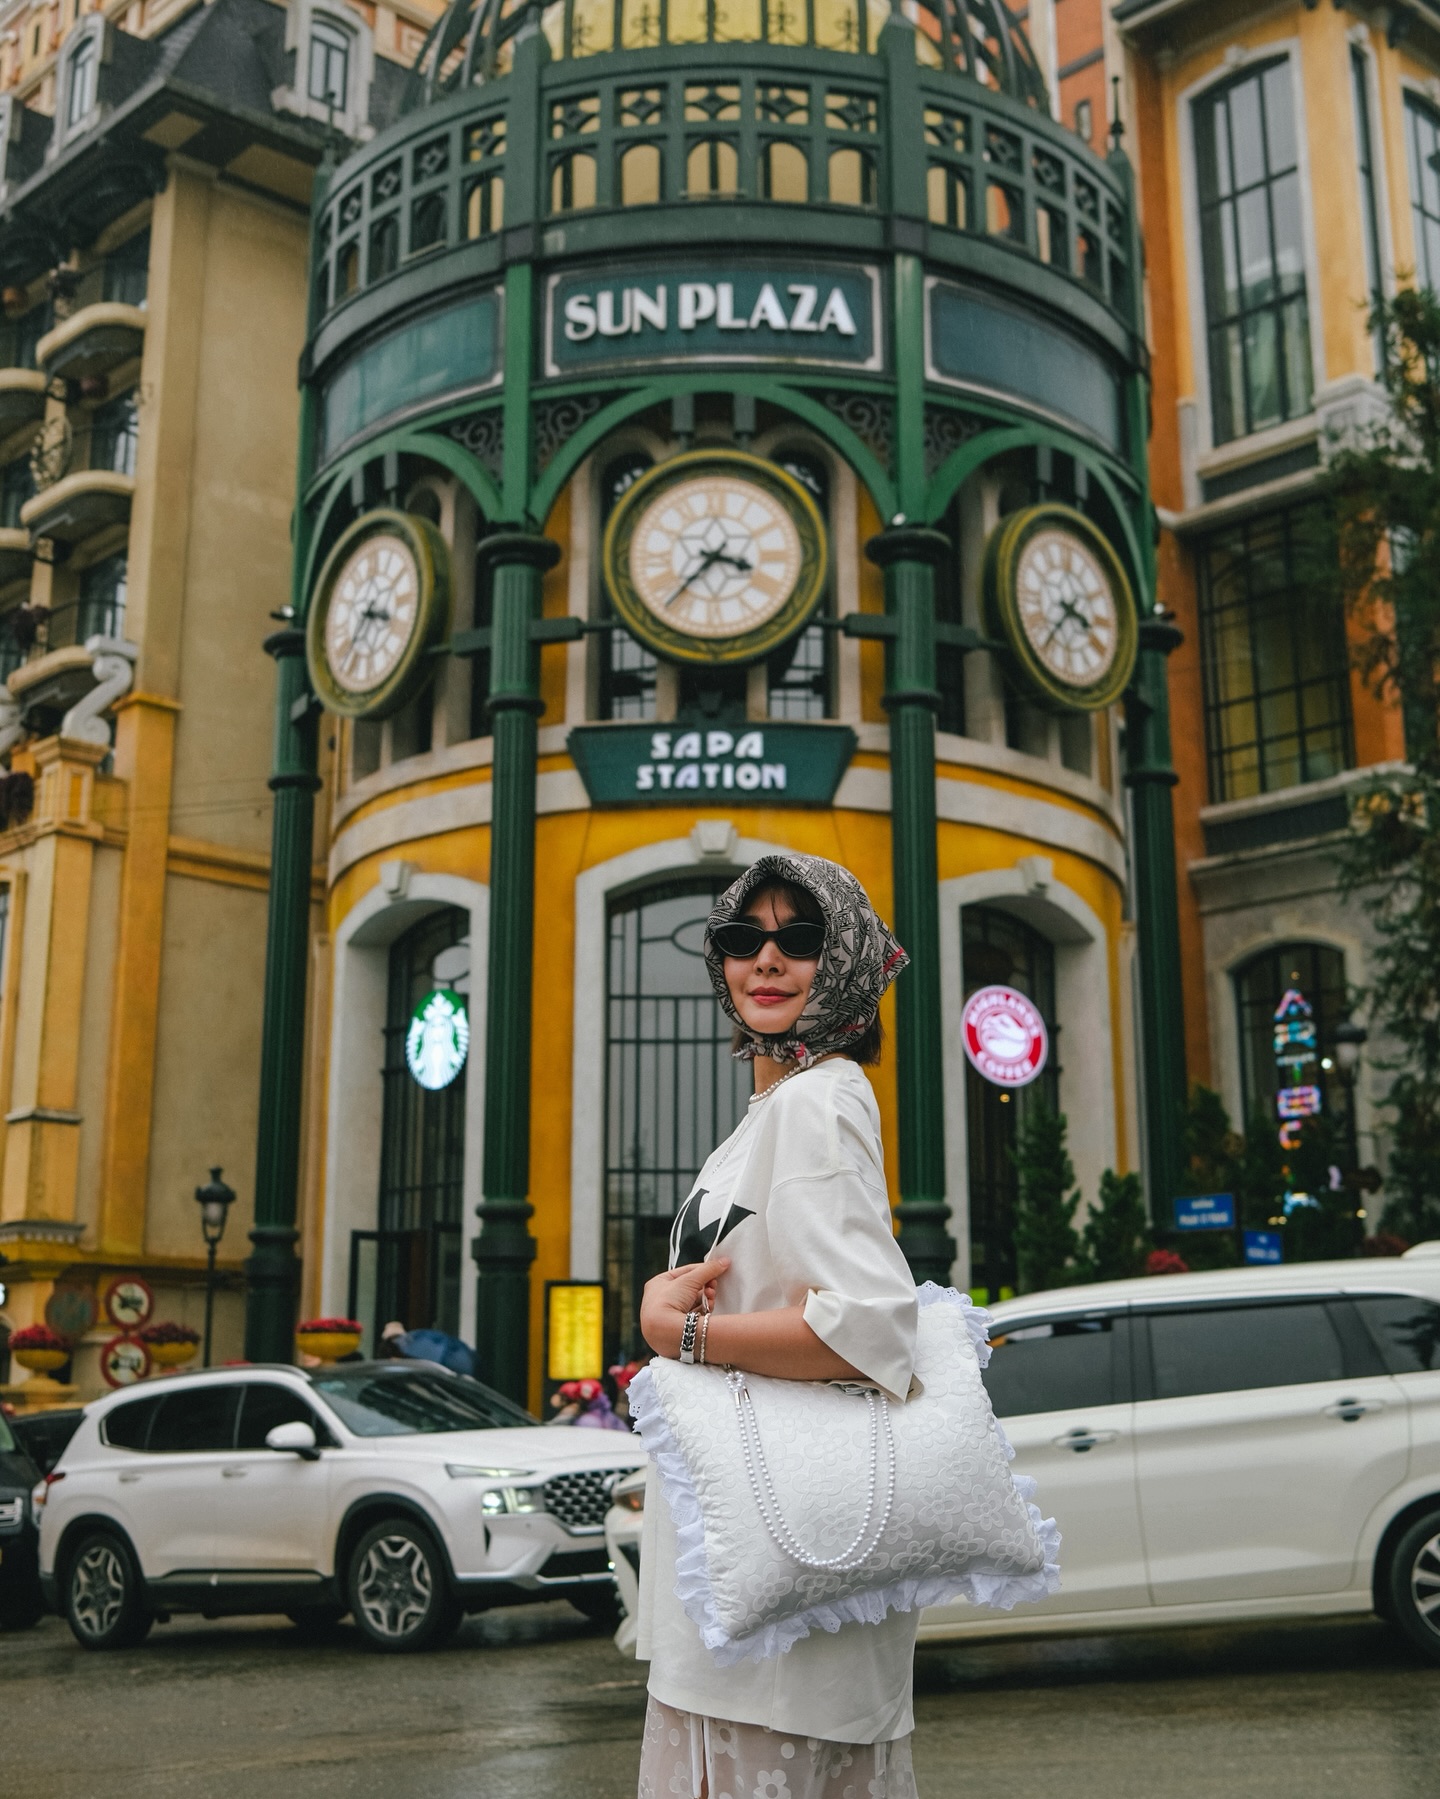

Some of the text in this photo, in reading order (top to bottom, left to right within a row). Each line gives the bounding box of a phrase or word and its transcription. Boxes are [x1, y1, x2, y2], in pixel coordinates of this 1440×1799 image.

[564, 282, 857, 341] SUN PLAZA
[651, 731, 763, 759] SAPA
[636, 763, 787, 790] STATION
